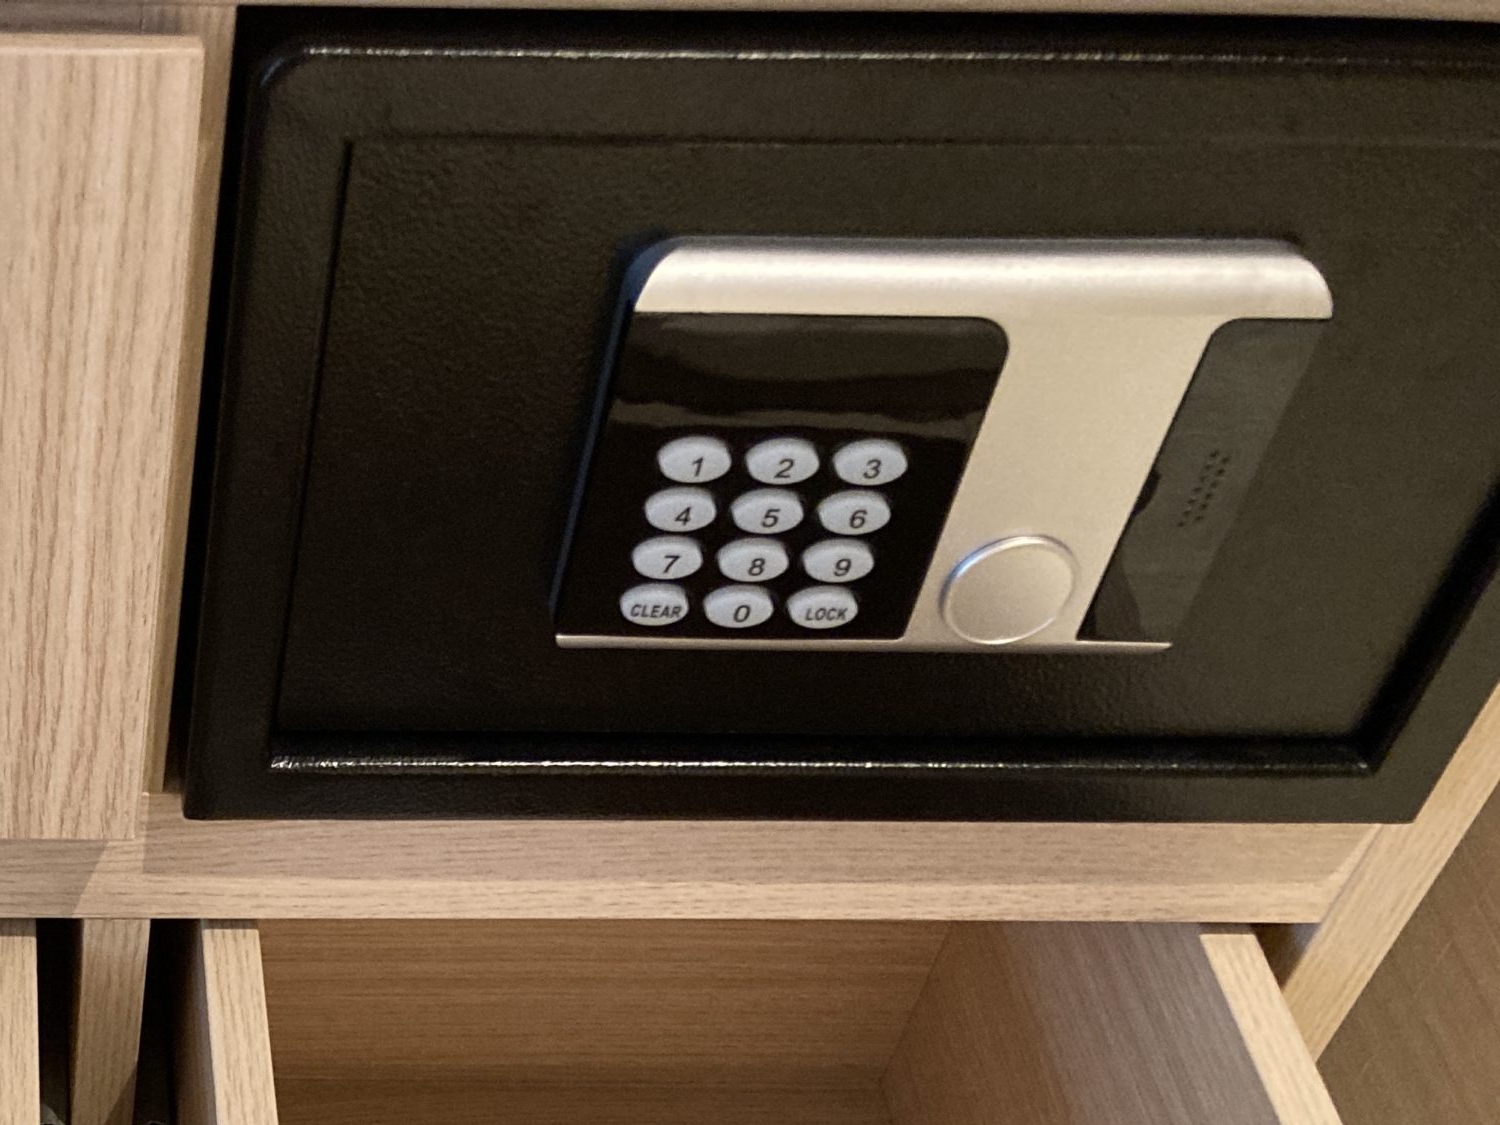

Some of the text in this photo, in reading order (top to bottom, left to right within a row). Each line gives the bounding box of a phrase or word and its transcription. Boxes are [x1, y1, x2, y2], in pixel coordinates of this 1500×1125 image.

[692, 457, 881, 479] 1 2 3
[676, 507, 868, 528] 4 5 6
[662, 555, 851, 576] 7 8 9
[630, 604, 848, 622] CLEAR 0 LOCK
